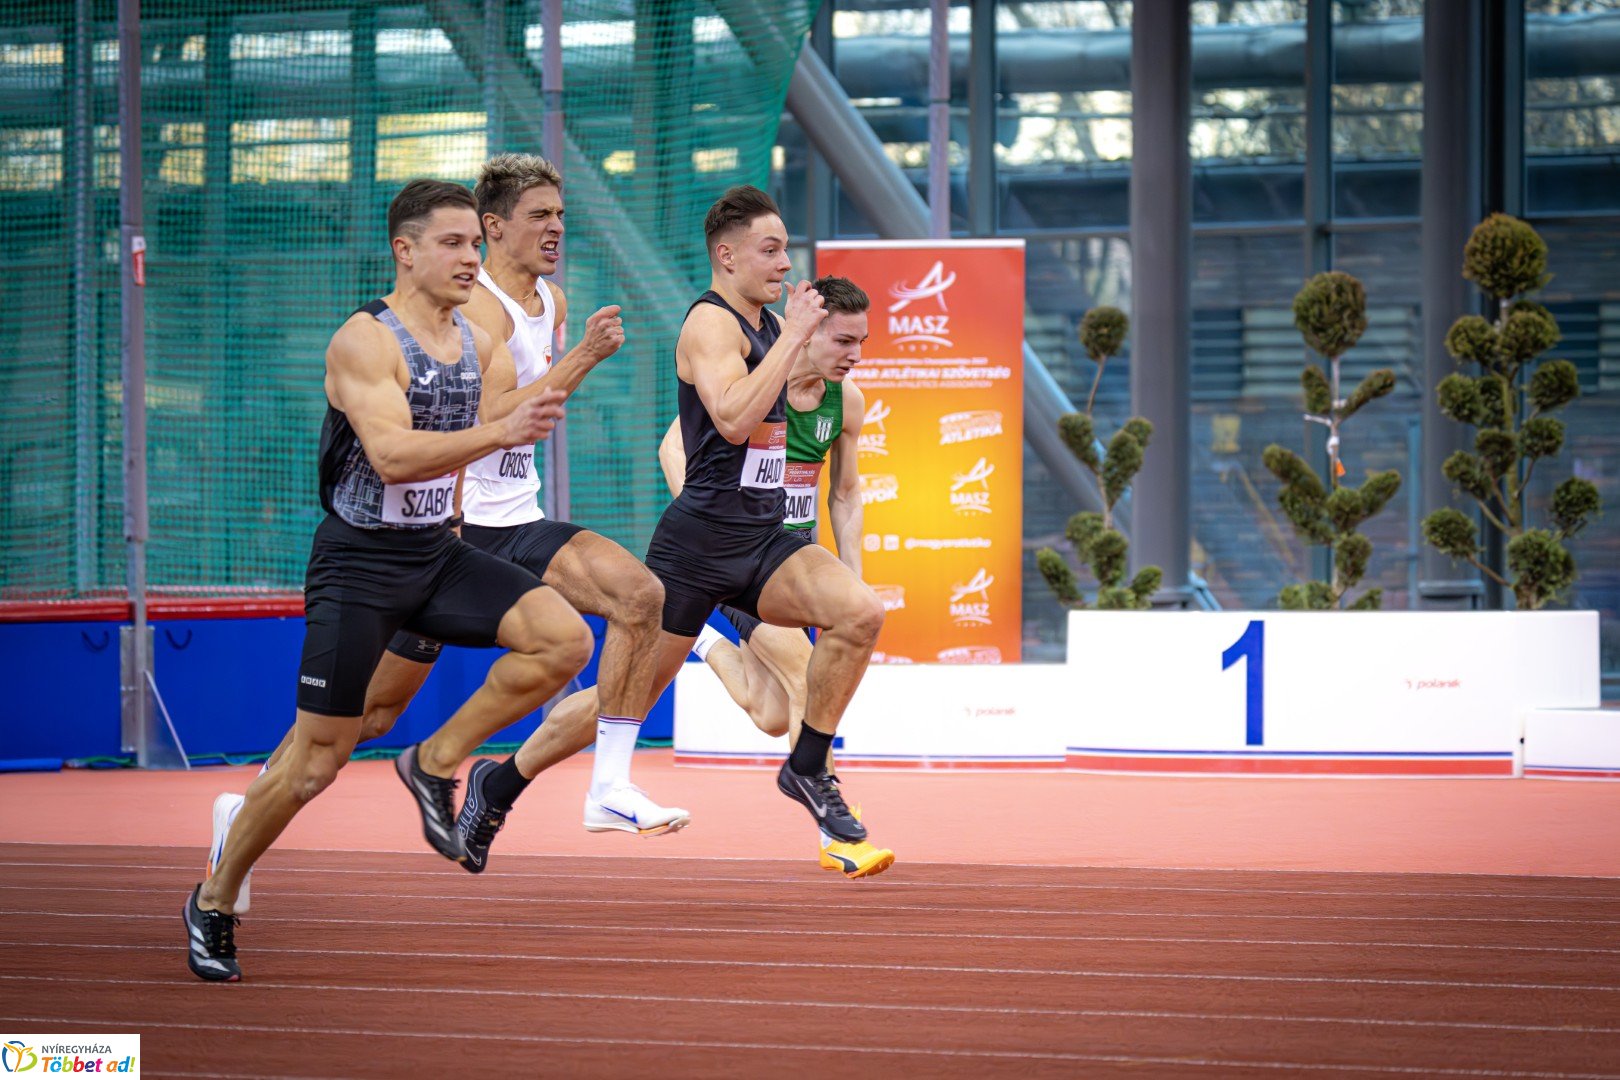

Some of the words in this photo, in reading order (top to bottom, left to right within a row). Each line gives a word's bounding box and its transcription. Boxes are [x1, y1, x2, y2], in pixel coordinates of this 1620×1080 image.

[889, 316, 949, 334] MASZ
[857, 434, 886, 448] ASZ
[499, 452, 532, 479] OROSZ
[786, 495, 812, 518] AND
[950, 493, 990, 505] MASZ
[950, 603, 990, 616] MASZ
[1222, 620, 1265, 746] 1
